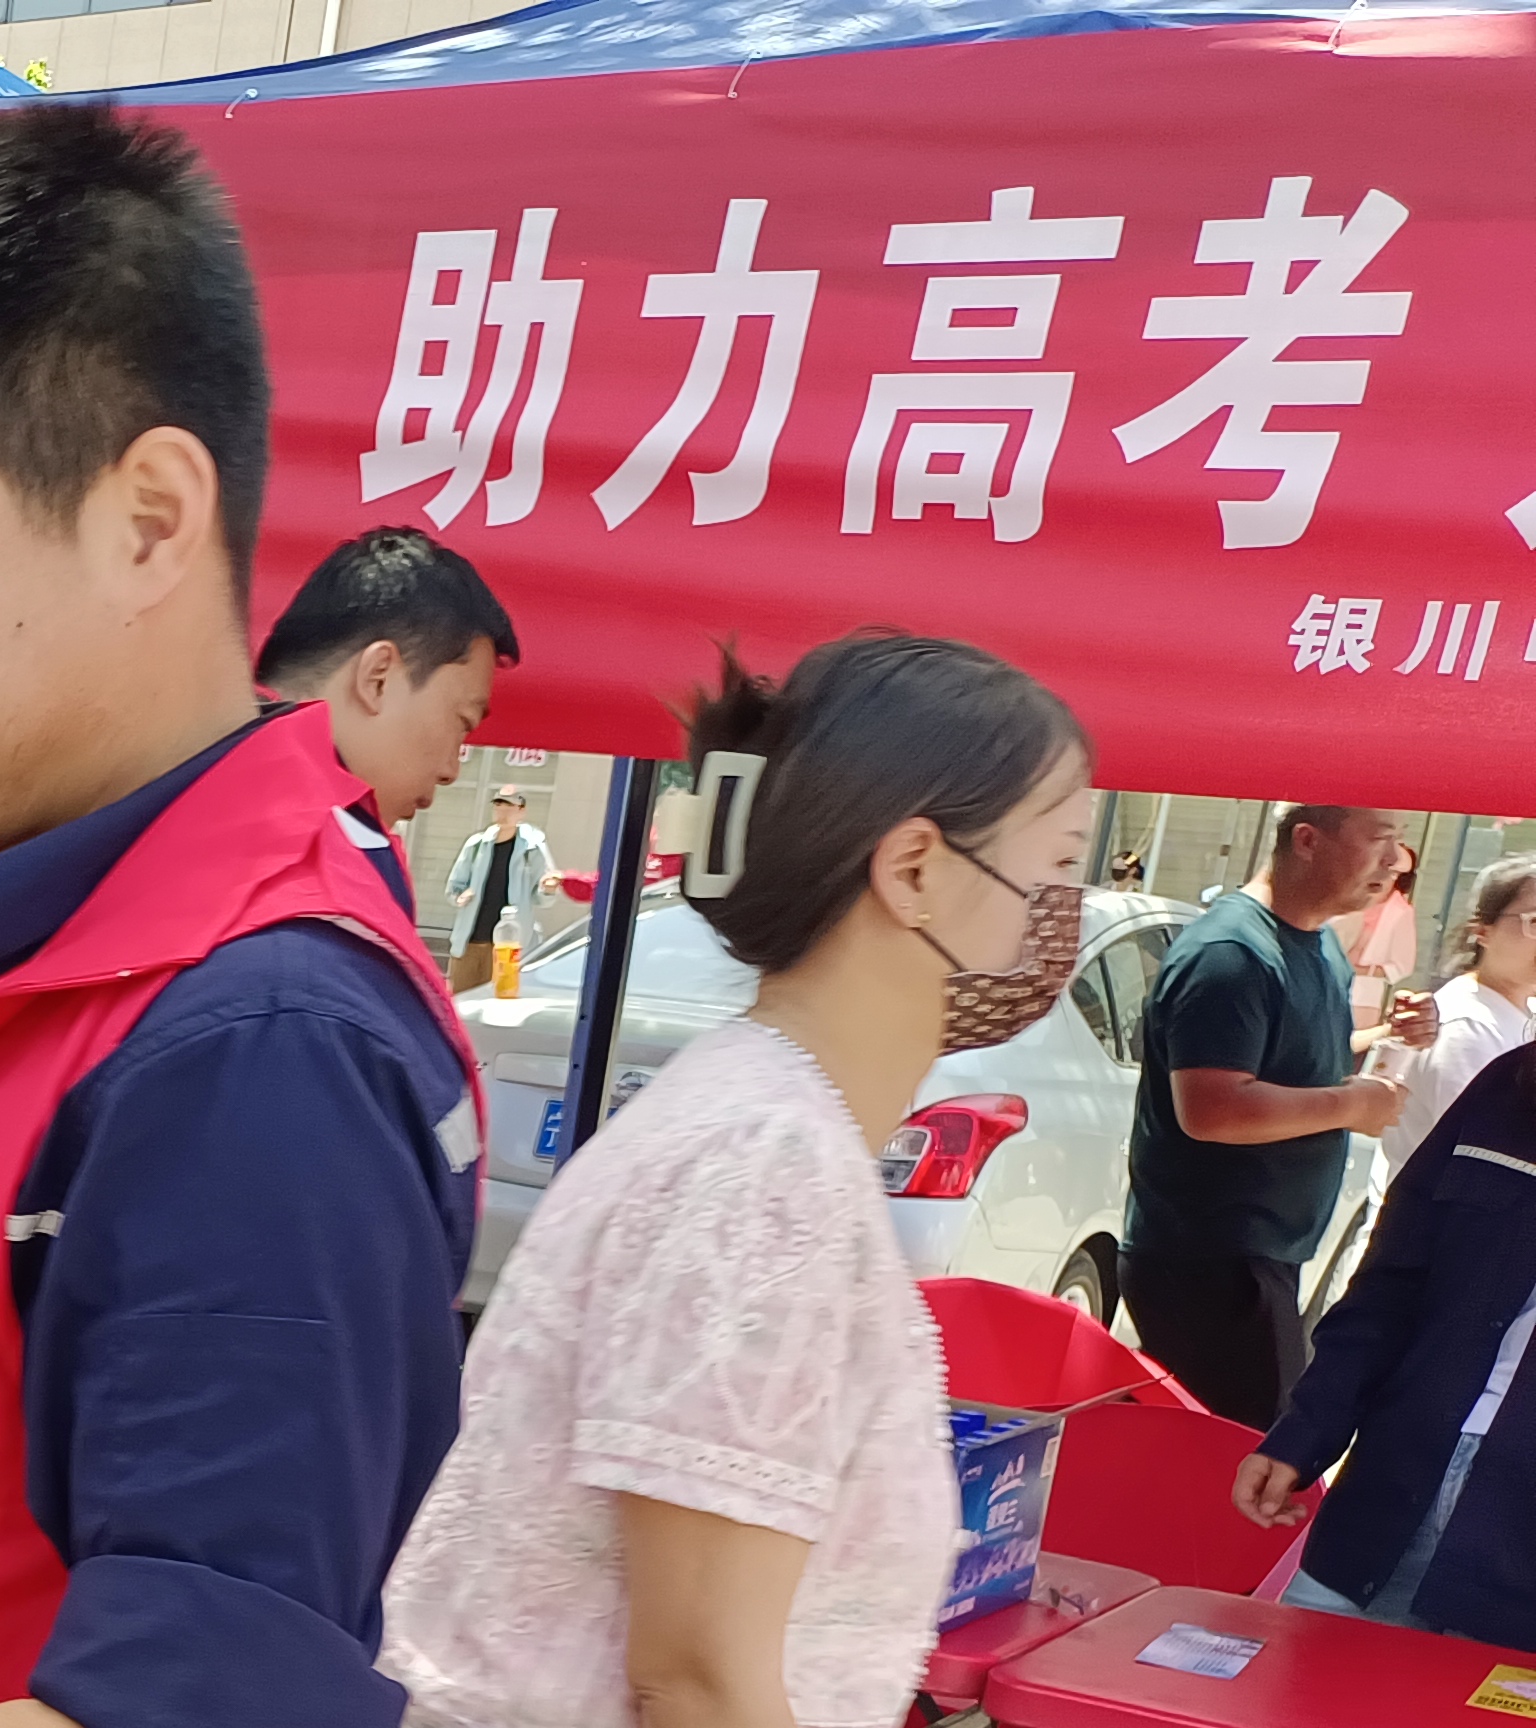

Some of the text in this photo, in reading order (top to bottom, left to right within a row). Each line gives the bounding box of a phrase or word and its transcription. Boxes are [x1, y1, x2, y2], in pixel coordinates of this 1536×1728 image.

[358, 174, 1536, 551] 助力高考
[1288, 593, 1536, 681] 银川
